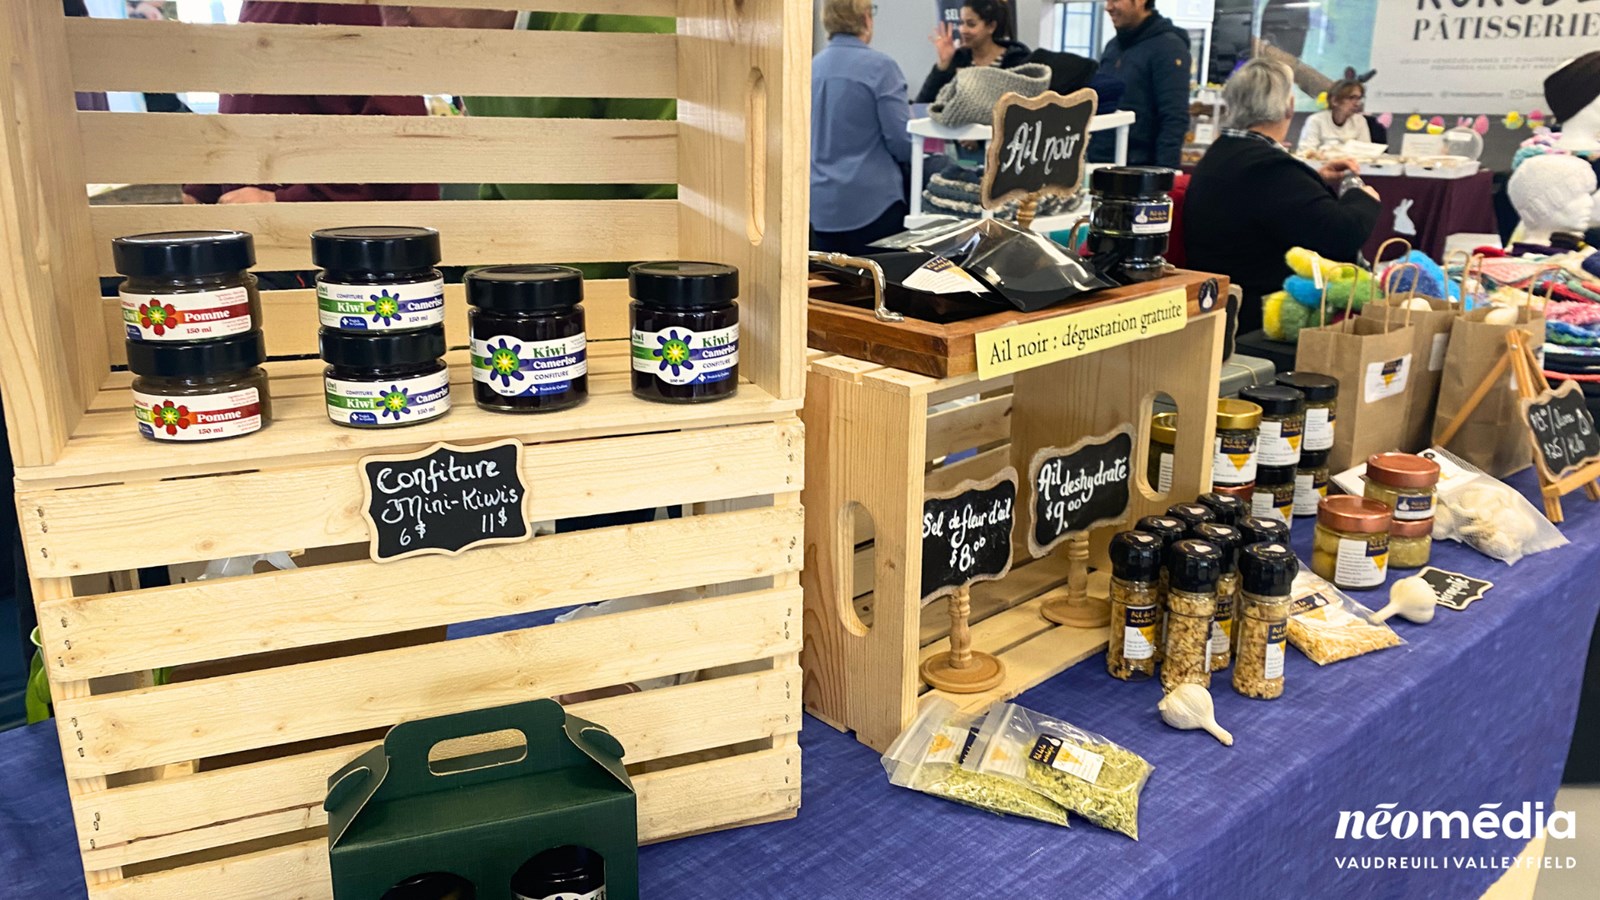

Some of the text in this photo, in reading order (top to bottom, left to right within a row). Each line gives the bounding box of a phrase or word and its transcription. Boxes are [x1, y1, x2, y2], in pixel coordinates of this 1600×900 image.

[1001, 120, 1080, 175] Ail noir
[337, 298, 443, 313] Kiwi Camerise
[183, 309, 230, 322] Pomme
[702, 333, 730, 347] Kiwi
[990, 337, 1013, 365] Ail
[1017, 332, 1049, 359] noir
[1062, 313, 1137, 351] dégustation
[1140, 300, 1182, 334] gratuite
[532, 343, 567, 358] Kiwi
[702, 344, 736, 358] Camerise
[532, 356, 577, 369] Camerise
[534, 370, 569, 380] CONFITURE
[346, 387, 449, 409] Kiwi Camerise
[196, 410, 242, 423] Pomme
[376, 455, 500, 494] Confiture
[1038, 459, 1061, 501] Ail
[381, 485, 519, 524] Mini-Kiwis
[922, 511, 944, 538] Sel
